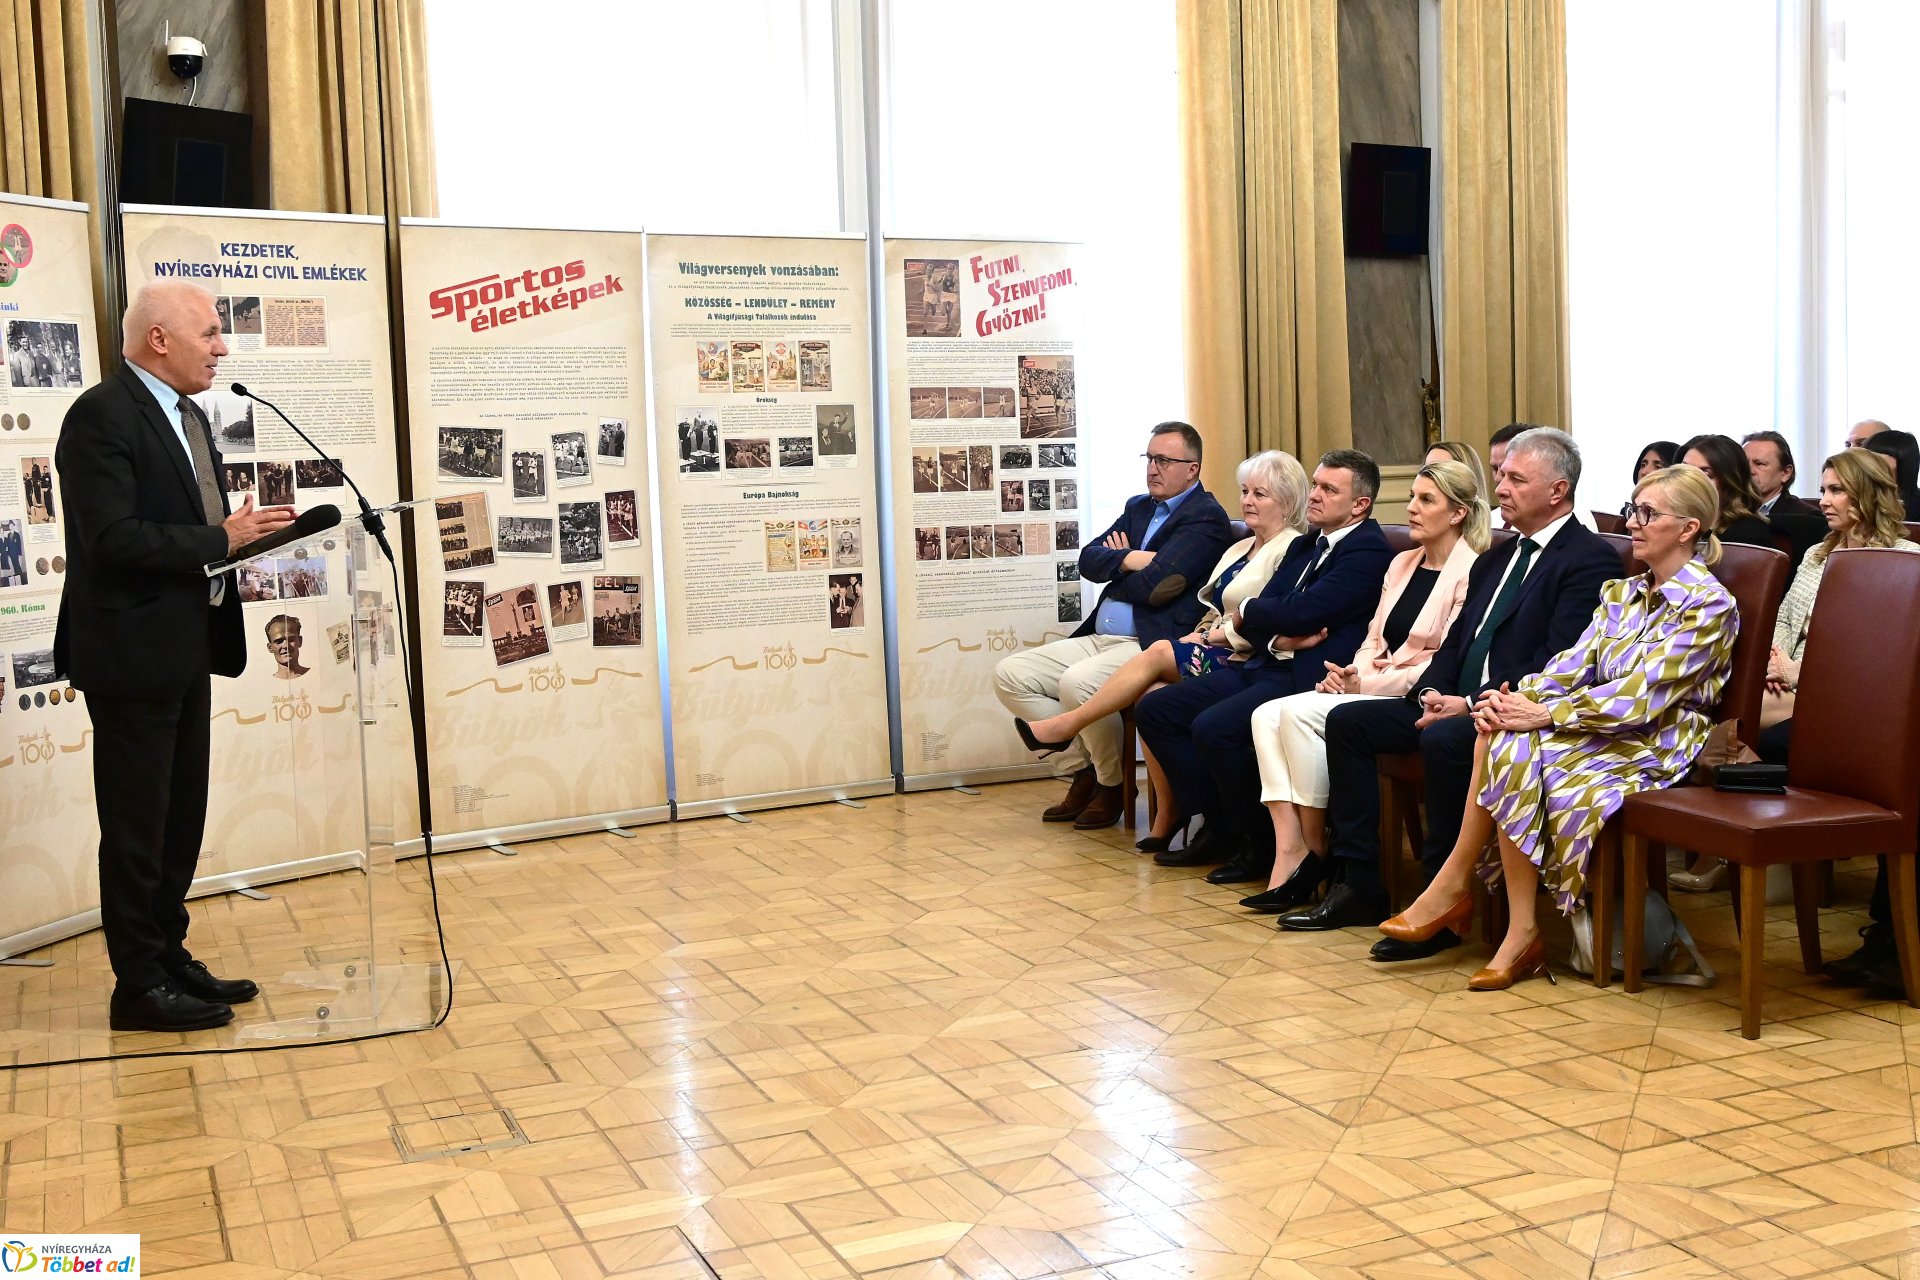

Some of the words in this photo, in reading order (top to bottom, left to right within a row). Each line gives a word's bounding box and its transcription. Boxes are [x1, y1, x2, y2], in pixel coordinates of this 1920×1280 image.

[221, 242, 300, 261] KEZDETEK,
[155, 260, 258, 280] NYÍREGYHÁZI
[262, 265, 299, 280] CIVIL
[302, 264, 367, 282] EMLÉKEK
[678, 262, 766, 277] Világversenyek
[770, 264, 839, 277] vonzásában:
[429, 259, 587, 322] Sportos
[470, 274, 624, 333] életképek
[684, 296, 732, 308] KÖZÖSSÉG
[744, 297, 788, 308] LENDÜLET
[799, 297, 836, 309] REMÉNY
[743, 492, 766, 500] Európa
[767, 490, 799, 499] Bajnokság
[594, 577, 620, 588] CÉL
[0, 606, 19, 615] 960.
[763, 653, 798, 671] 100
[528, 674, 566, 692] 100
[272, 703, 313, 723] 100
[19, 742, 56, 766] 100
